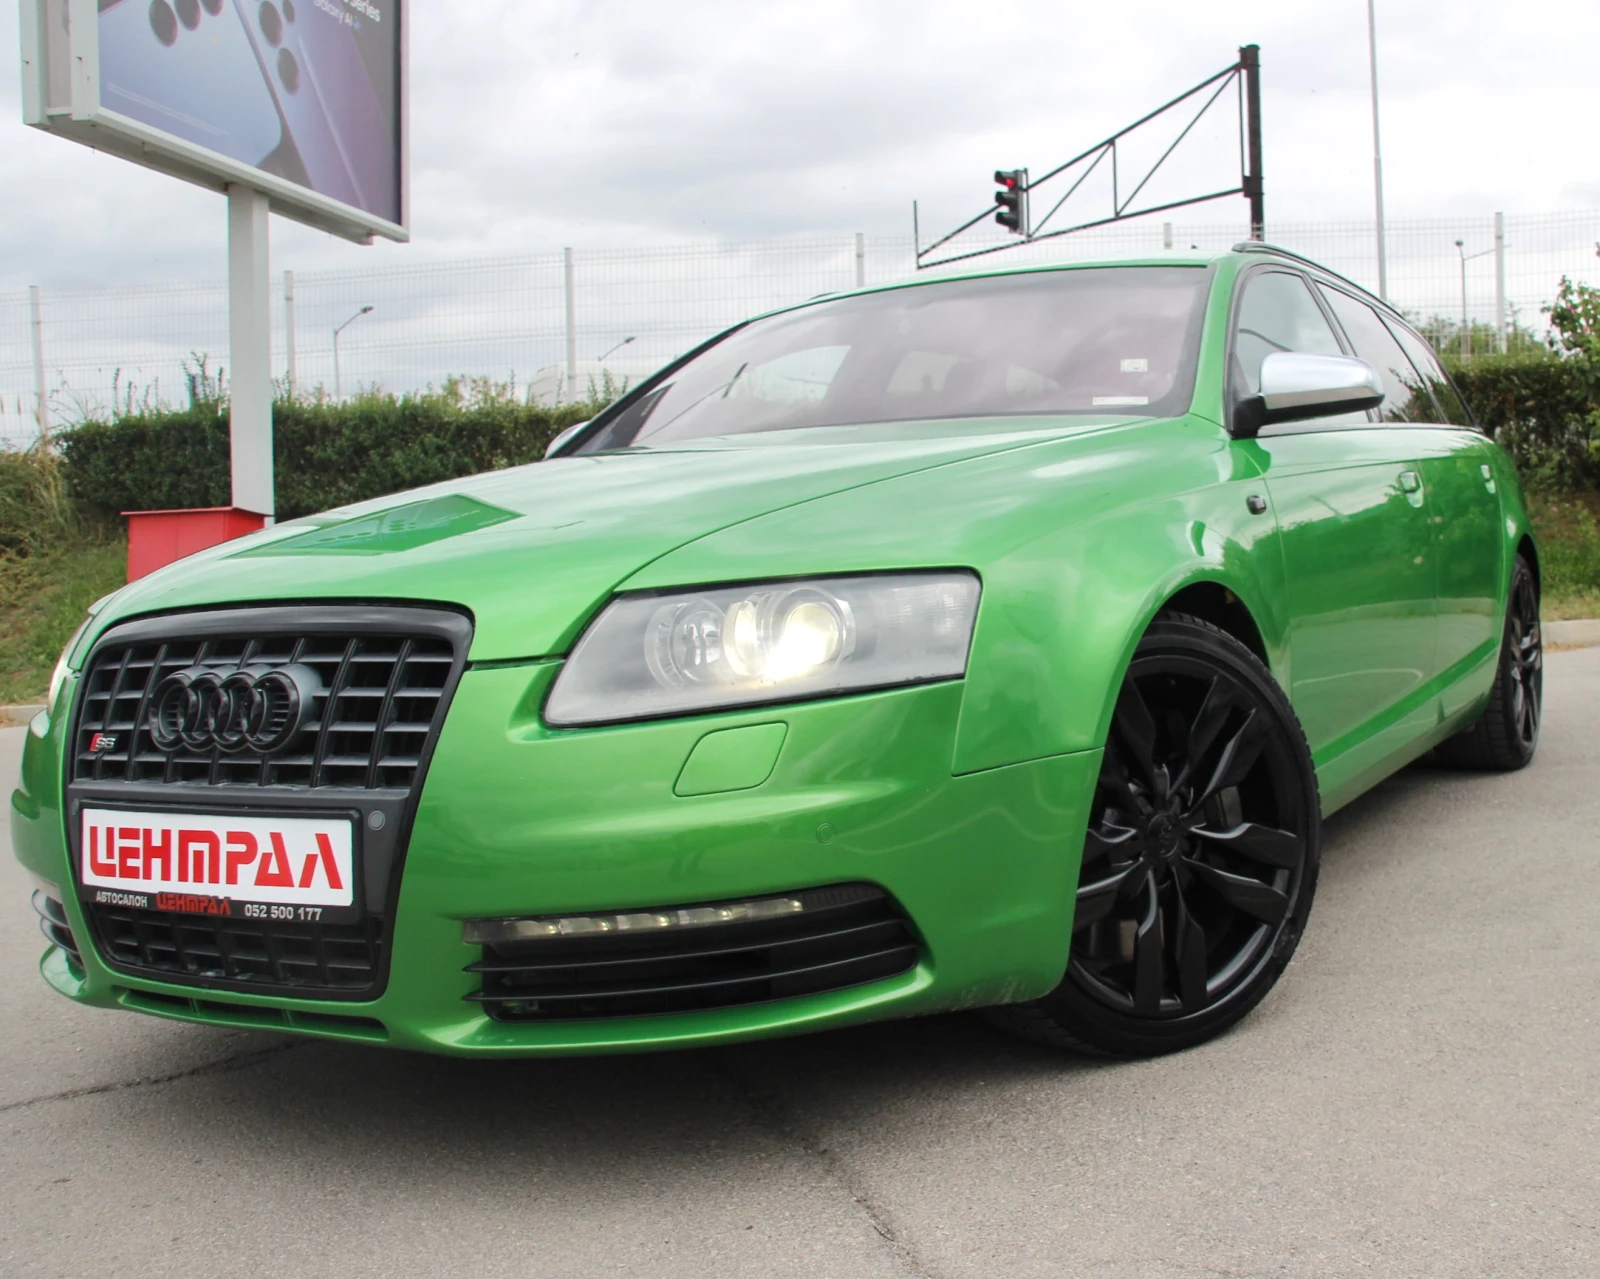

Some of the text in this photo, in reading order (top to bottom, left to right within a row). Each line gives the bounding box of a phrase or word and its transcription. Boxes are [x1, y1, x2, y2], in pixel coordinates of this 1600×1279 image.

[95, 890, 148, 908] АВТОСАЛОН
[244, 903, 268, 918] 052
[270, 905, 295, 920] 500
[297, 906, 322, 921] 177
